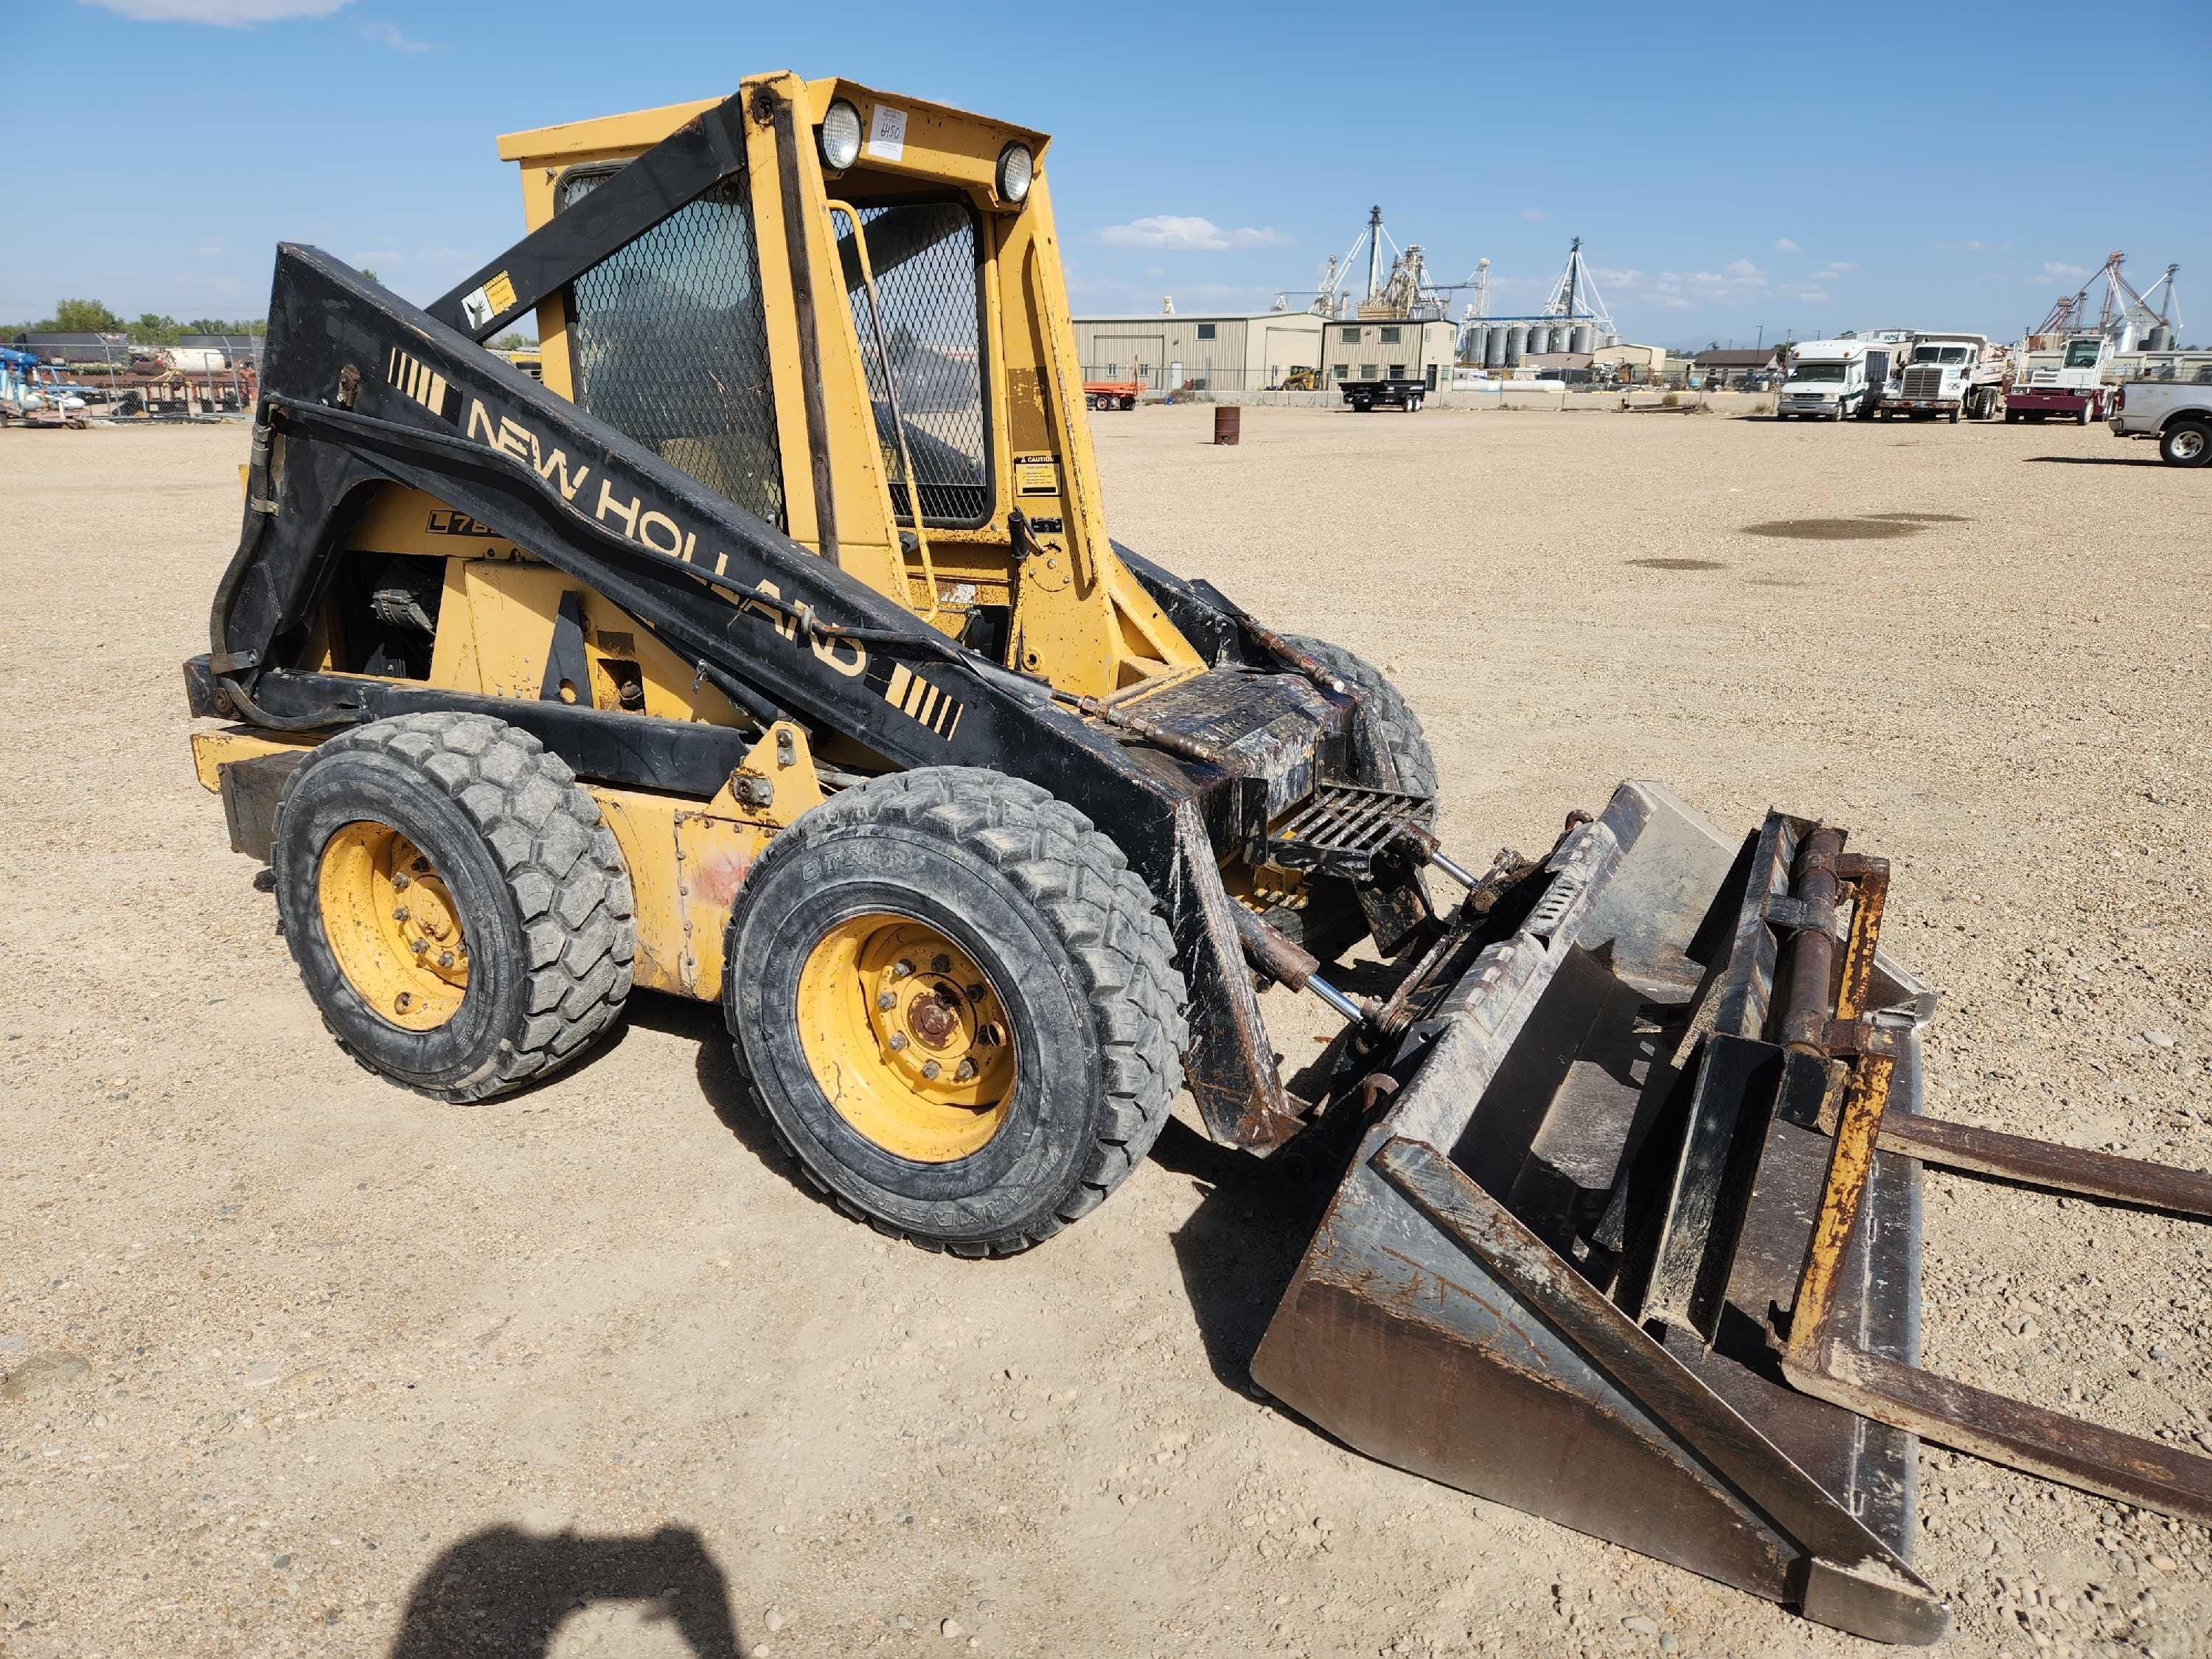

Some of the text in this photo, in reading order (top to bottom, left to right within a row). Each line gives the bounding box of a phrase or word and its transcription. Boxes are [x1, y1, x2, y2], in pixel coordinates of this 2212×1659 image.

[880, 122, 900, 139] 6450
[428, 512, 498, 533] L78
[467, 398, 866, 677] NEW HOLLAND
